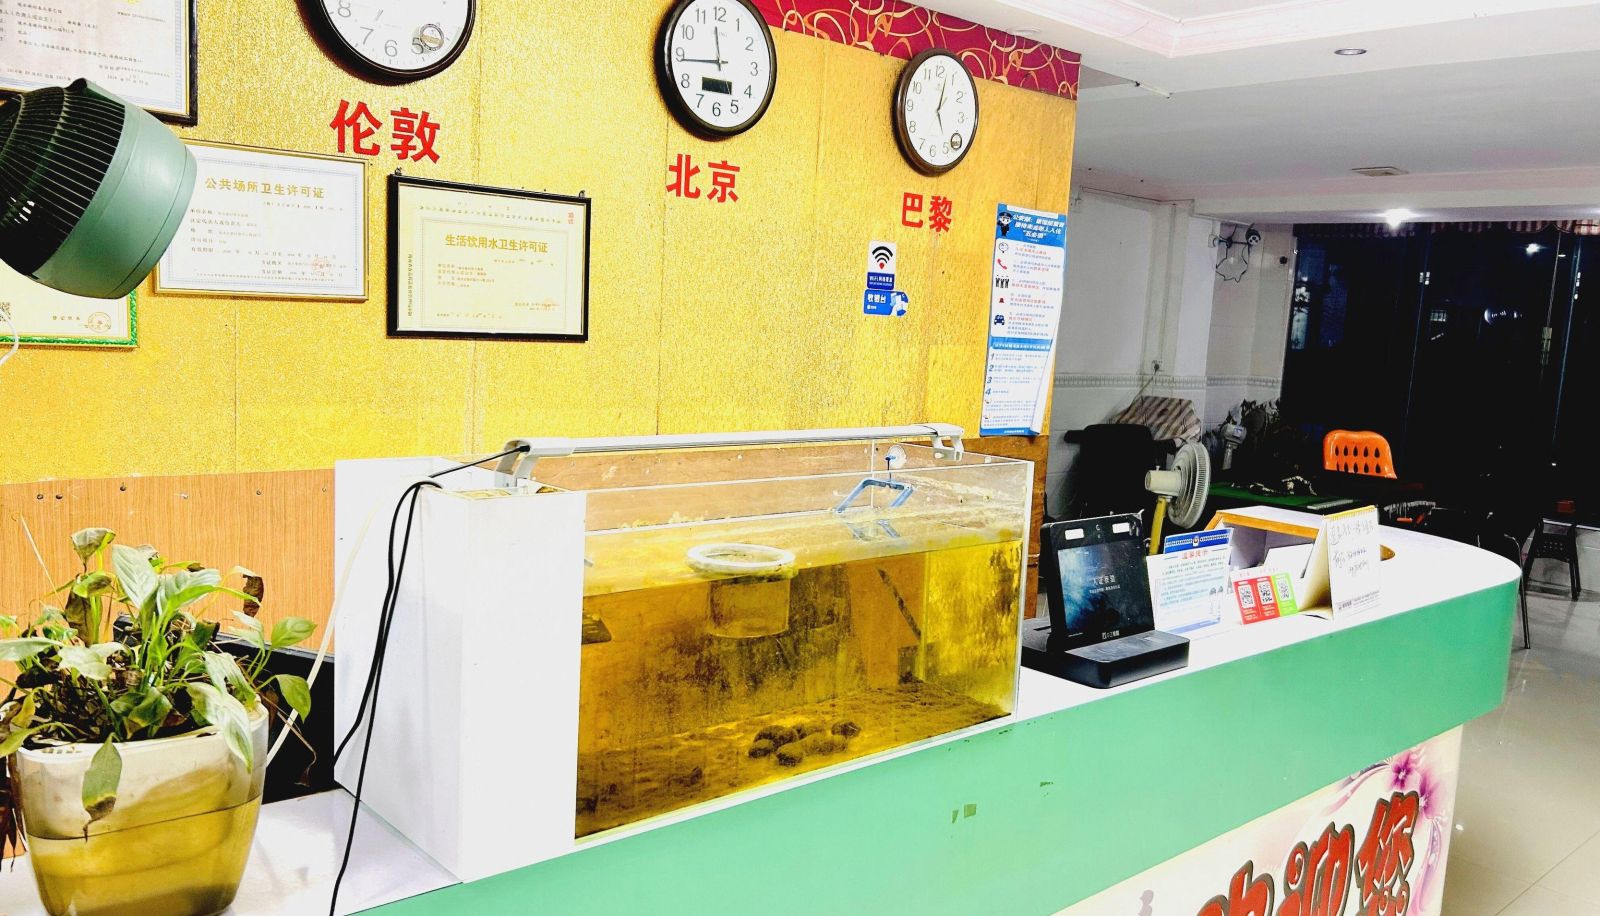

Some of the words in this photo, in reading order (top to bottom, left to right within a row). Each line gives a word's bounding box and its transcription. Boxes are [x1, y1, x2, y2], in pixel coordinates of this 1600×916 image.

[338, 0, 351, 18] 8
[695, 8, 706, 25] 11
[713, 6, 727, 23] 12
[681, 24, 695, 41] 10
[735, 18, 740, 33] 1
[360, 26, 374, 45] 7
[384, 39, 398, 57] 6
[411, 37, 424, 55] 5
[745, 36, 754, 52] 2
[675, 46, 685, 63] 9
[750, 61, 759, 77] 3
[924, 68, 931, 80] 11
[935, 65, 945, 79] 12
[680, 73, 690, 89] 8
[913, 81, 922, 95] 10
[744, 84, 752, 99] 4
[955, 91, 964, 104] 2
[695, 93, 705, 108] 7
[730, 99, 739, 114] 5
[906, 99, 914, 111] 9
[712, 102, 721, 117] 6
[957, 112, 965, 124] 3
[330, 99, 441, 164] 伦敦
[908, 121, 916, 133] 8
[919, 137, 926, 150] 7
[929, 145, 937, 157] 6
[942, 142, 949, 154] 5
[666, 153, 741, 203] 北京
[204, 177, 325, 199] 公共场所卫生许可证
[901, 192, 953, 233] 巴黎
[445, 234, 548, 254] 生活饮用水卫生许可证
[867, 293, 886, 304] 收银台
[989, 364, 994, 372] 2
[987, 376, 992, 384] 3
[985, 388, 991, 396] 4
